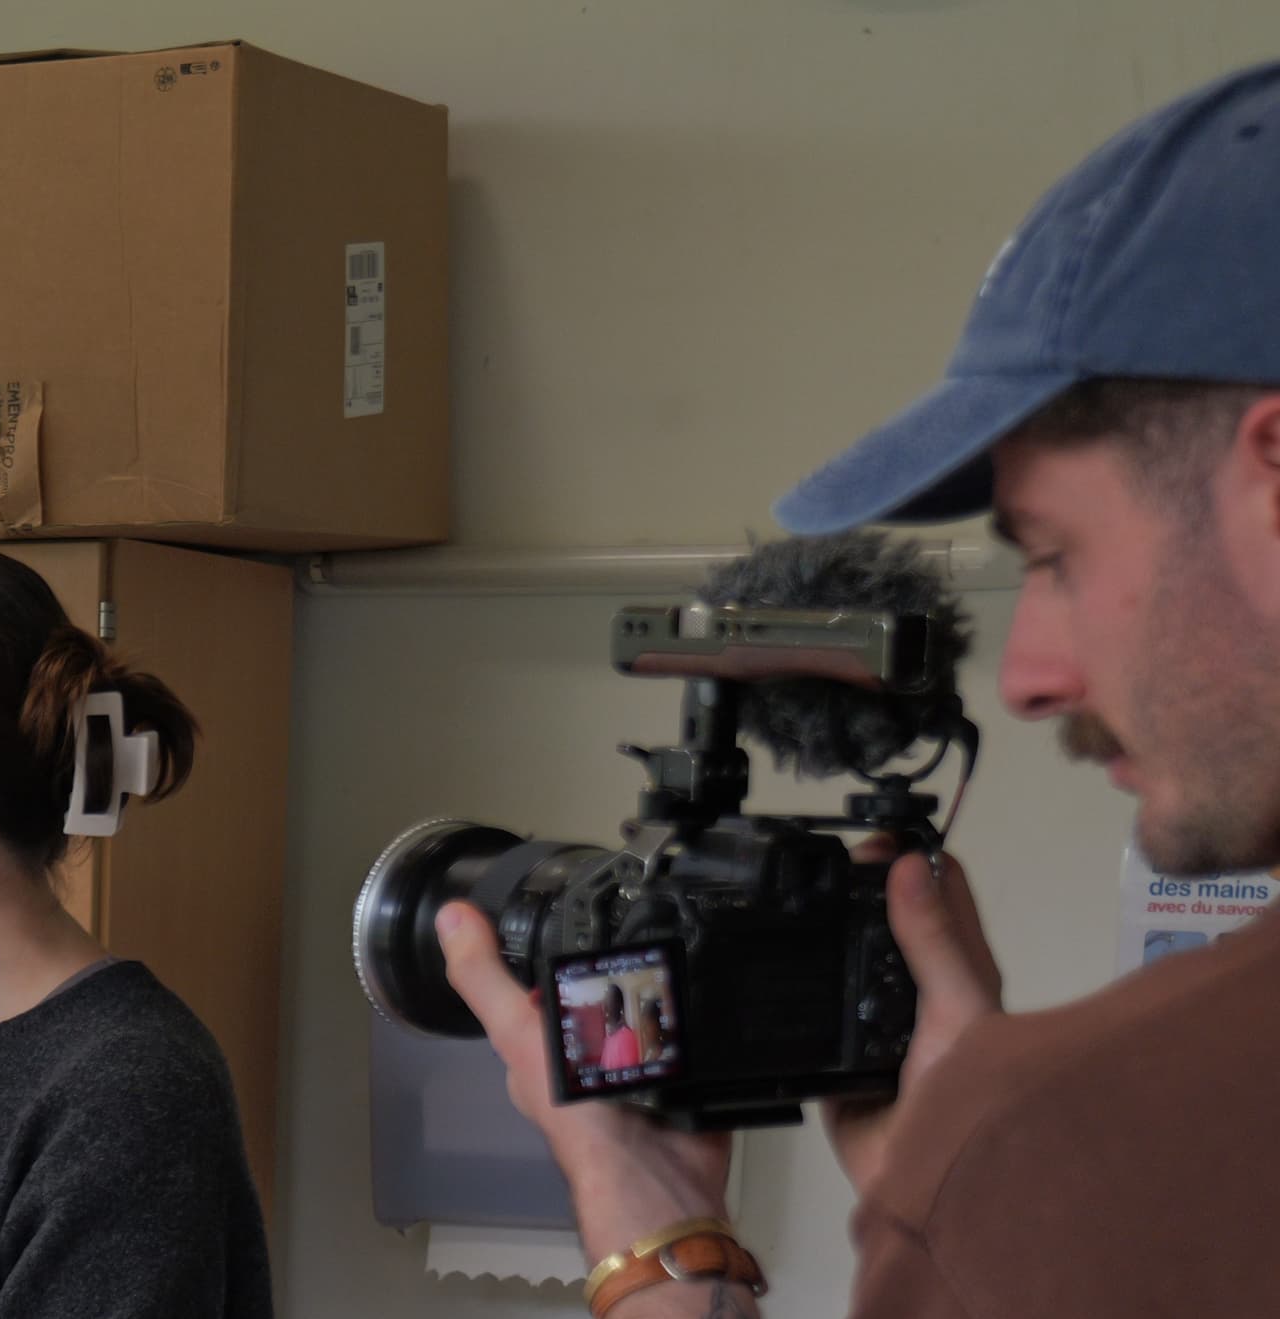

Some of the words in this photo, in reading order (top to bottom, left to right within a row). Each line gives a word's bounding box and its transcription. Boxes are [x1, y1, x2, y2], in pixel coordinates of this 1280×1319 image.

[1149, 877, 1192, 897] des
[1198, 880, 1268, 899] mains
[1147, 901, 1186, 914] avec
[1191, 901, 1212, 914] du
